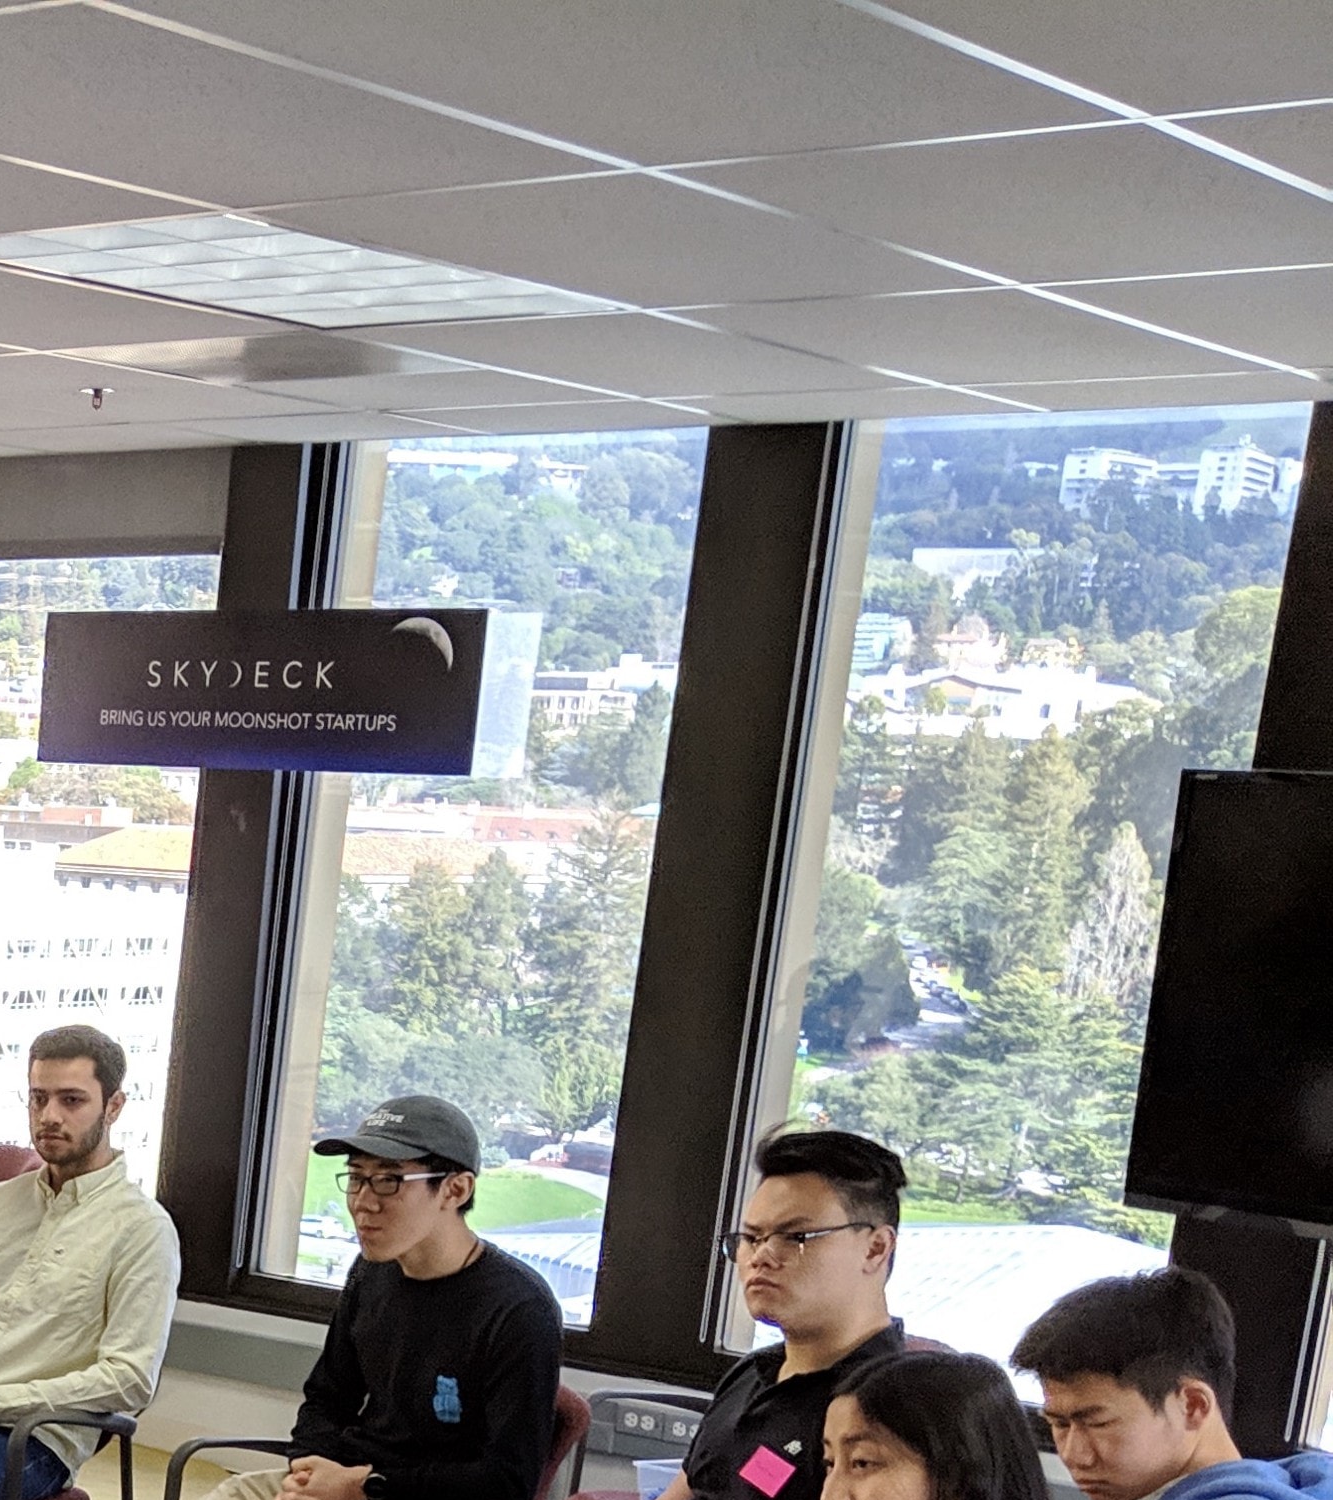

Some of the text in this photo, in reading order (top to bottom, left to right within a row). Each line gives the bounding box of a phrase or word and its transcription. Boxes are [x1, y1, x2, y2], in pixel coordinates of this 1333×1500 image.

[99, 709, 398, 732] BRING US YOUR MOONSHOT STARTUPS
